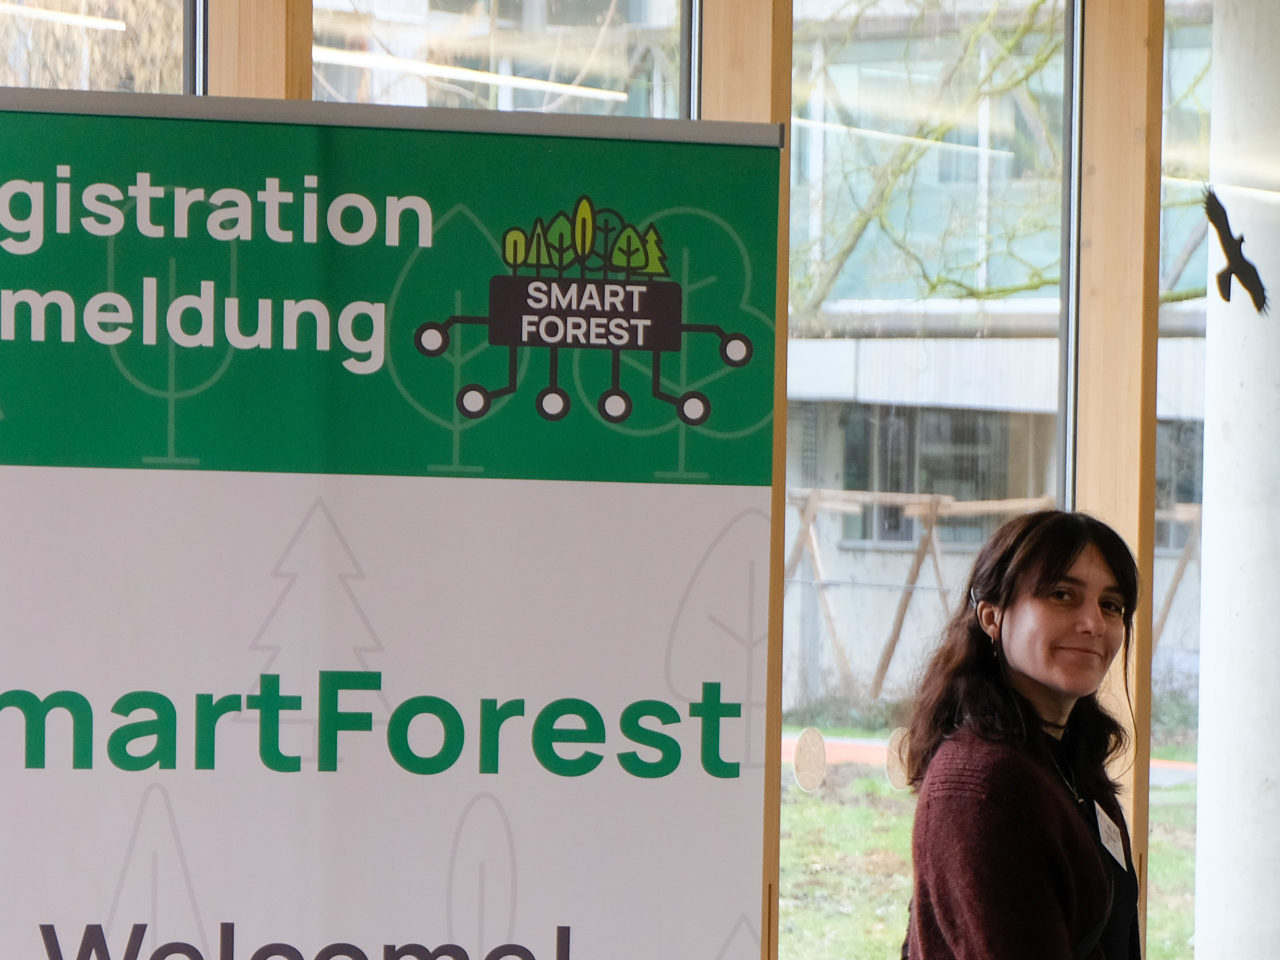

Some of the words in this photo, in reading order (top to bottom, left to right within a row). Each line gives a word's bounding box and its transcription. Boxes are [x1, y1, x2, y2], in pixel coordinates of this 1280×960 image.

[0, 164, 433, 255] gistration
[0, 276, 386, 375] meldung
[521, 314, 652, 346] FOREST
[526, 281, 647, 313] SMART
[0, 671, 742, 778] martForest
